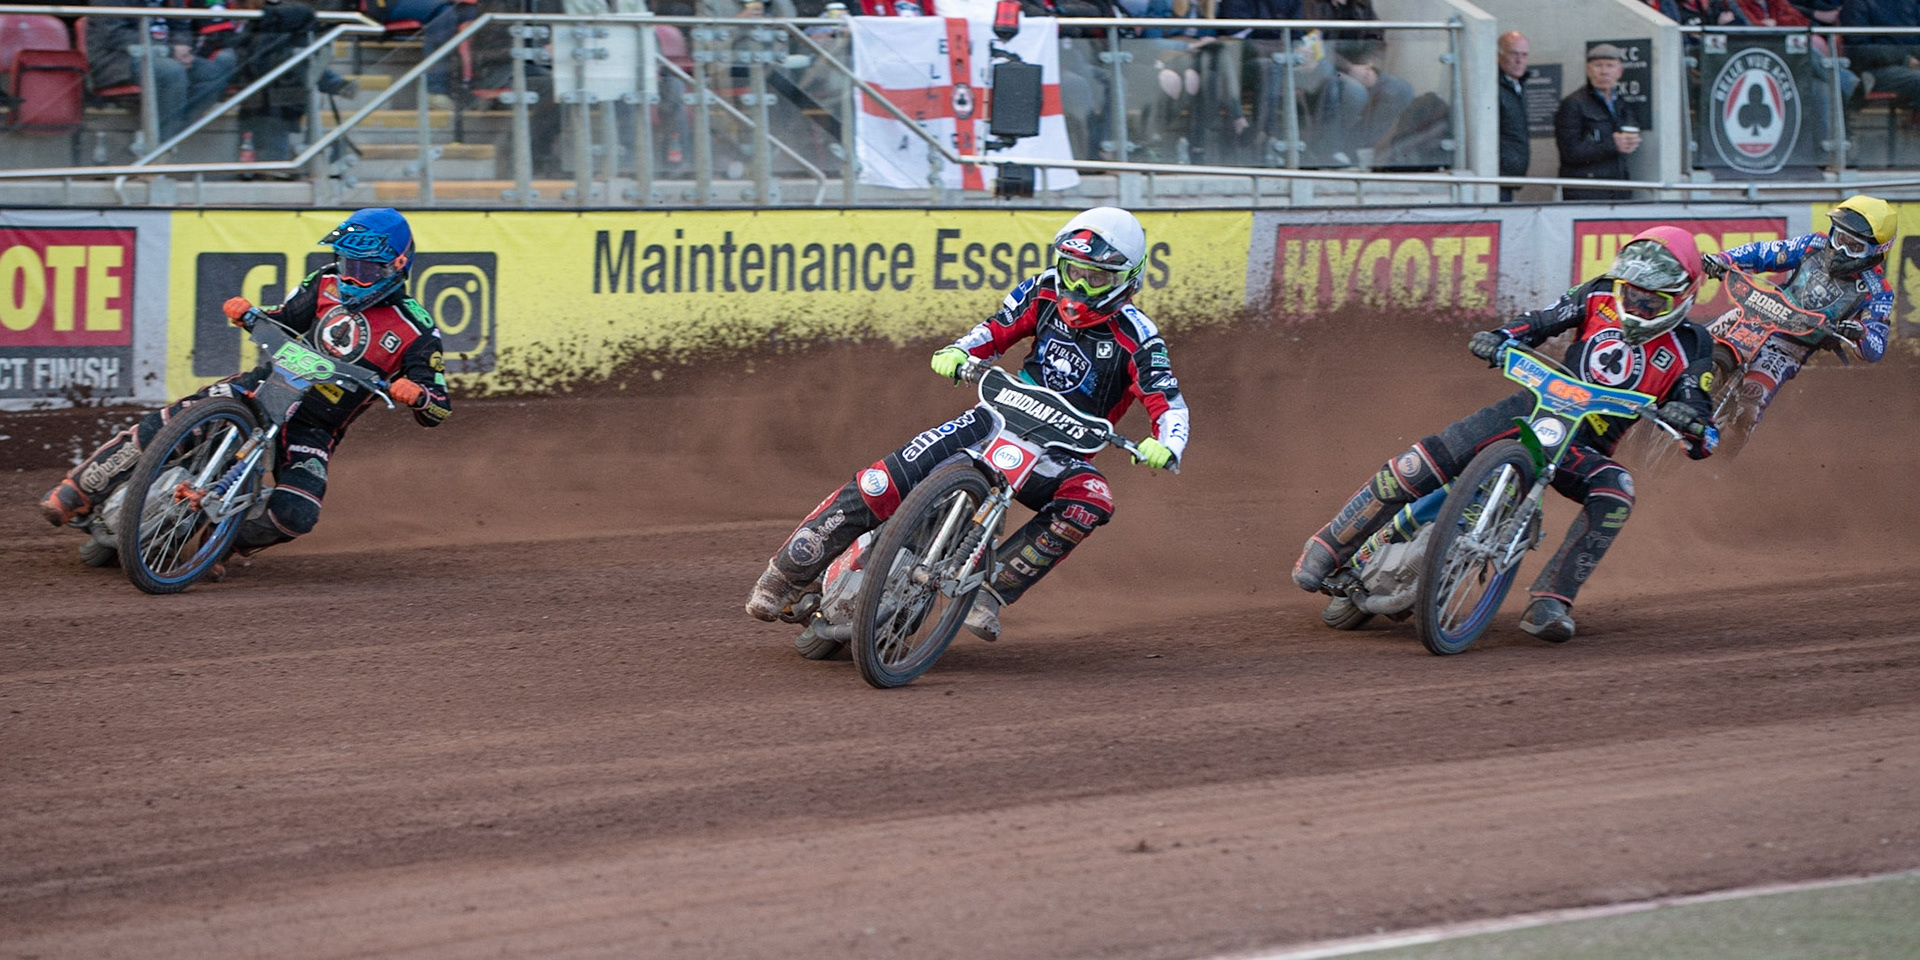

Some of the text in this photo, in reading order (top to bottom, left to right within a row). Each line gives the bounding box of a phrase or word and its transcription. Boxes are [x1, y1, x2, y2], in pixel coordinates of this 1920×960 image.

[592, 228, 916, 294] Maintenance
[1283, 236, 1491, 313] HYCOTE
[1748, 289, 1793, 321] BORGE
[384, 335, 398, 349] 6
[1098, 343, 1112, 357] 3
[1594, 331, 1621, 343] BELLE
[1049, 342, 1088, 371] PIRATES
[1655, 351, 1671, 367] 3
[33, 357, 120, 390] FINISH
[994, 387, 1089, 440] MERIDIAN LIFTS
[902, 408, 976, 462] alflow
[288, 444, 329, 461] MOTUL
[999, 450, 1019, 464] ATPI
[1061, 503, 1100, 527] jhr
[1331, 487, 1374, 535] ALBON
